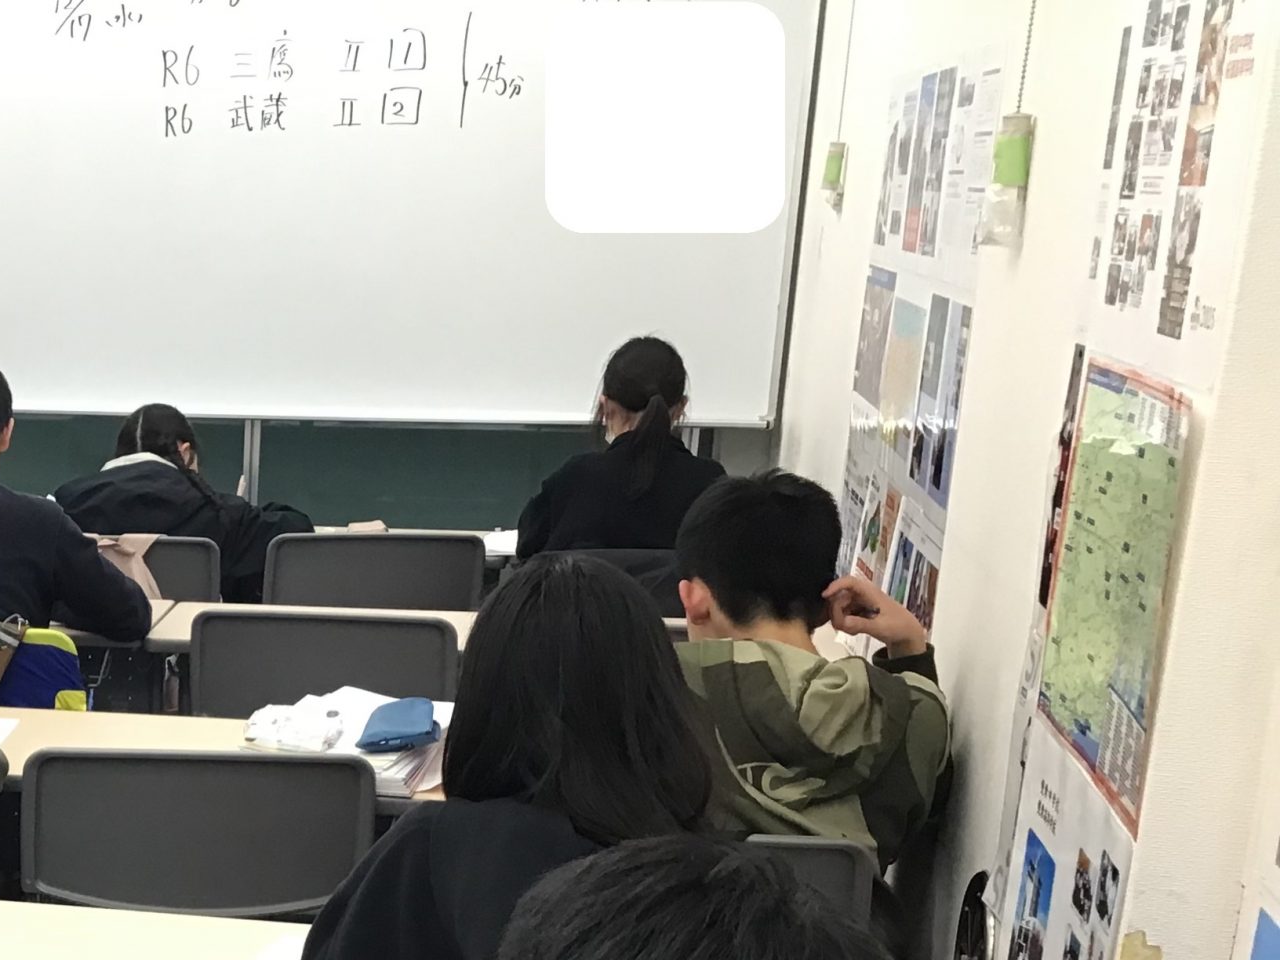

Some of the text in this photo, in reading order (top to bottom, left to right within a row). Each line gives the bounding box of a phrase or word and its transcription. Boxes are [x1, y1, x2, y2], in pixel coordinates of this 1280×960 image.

[162, 45, 200, 87] R6
[477, 54, 525, 99] 45分
[165, 103, 193, 137] R6
